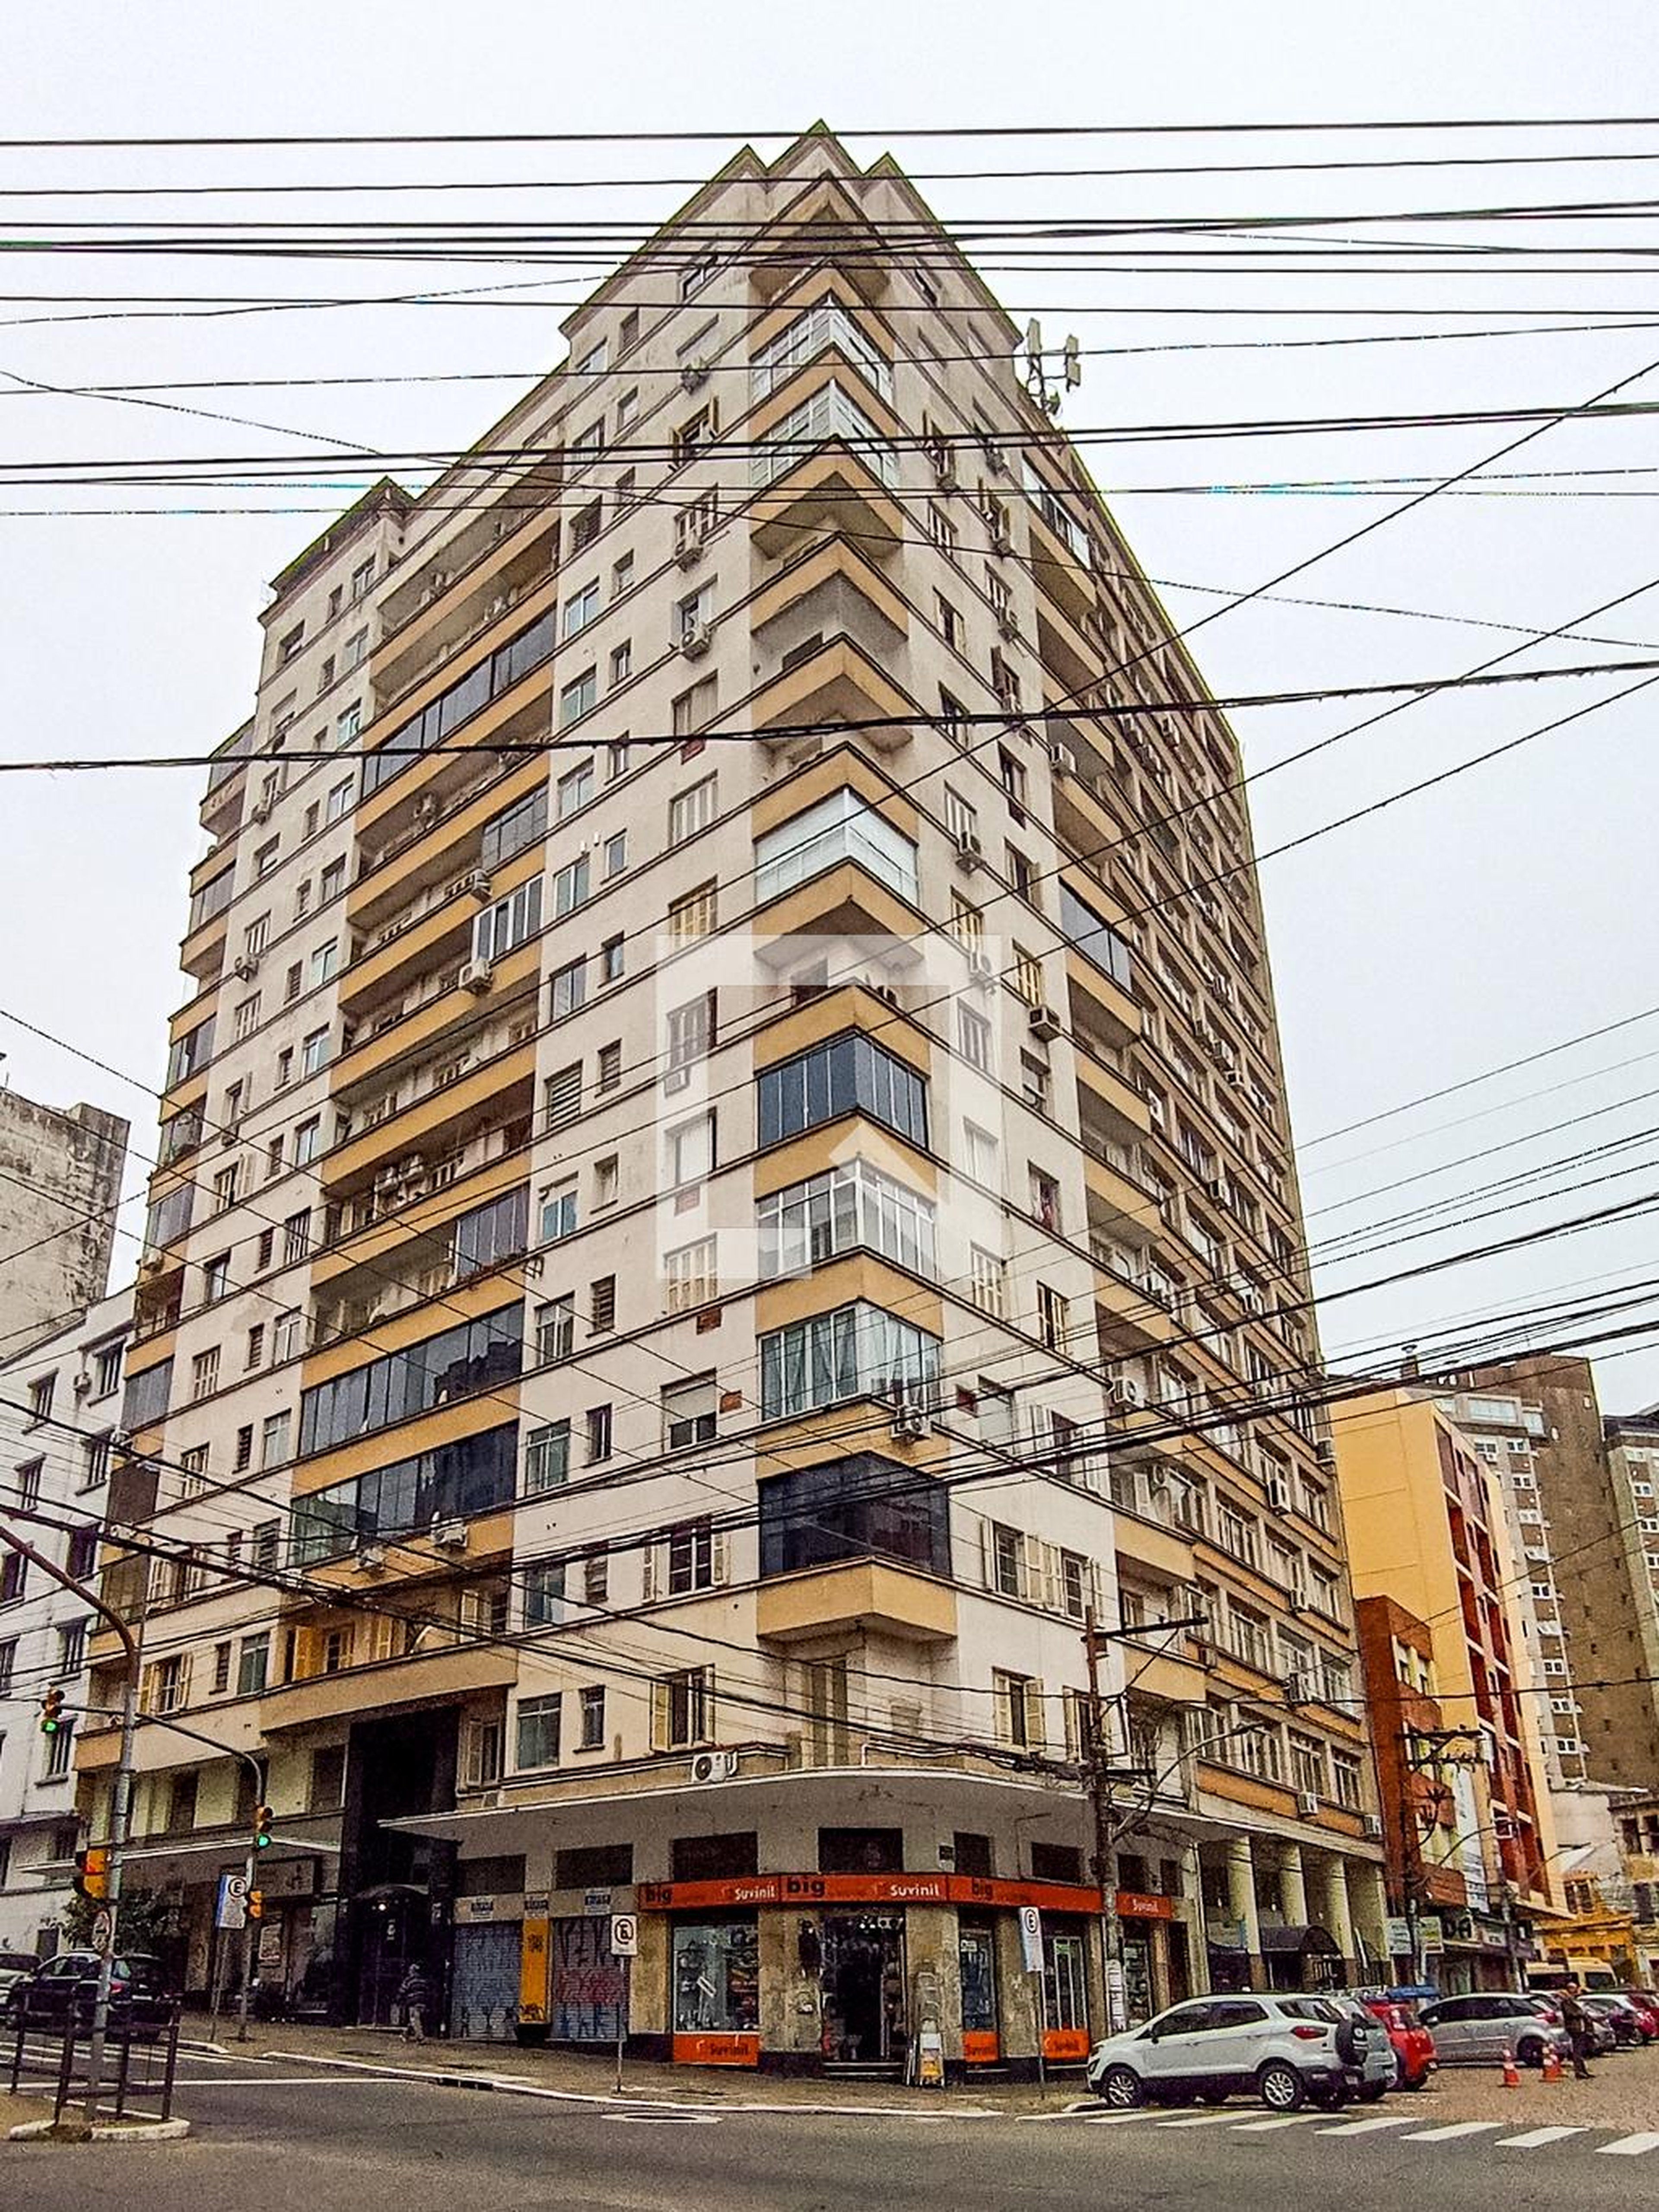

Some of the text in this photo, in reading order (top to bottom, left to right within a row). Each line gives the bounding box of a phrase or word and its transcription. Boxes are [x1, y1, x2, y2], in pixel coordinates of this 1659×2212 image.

[735, 1884, 775, 1901] Suvinil
[787, 1876, 825, 1897] big
[890, 1883, 939, 1897] Suvinil
[709, 2042, 750, 2056] Suvinil
